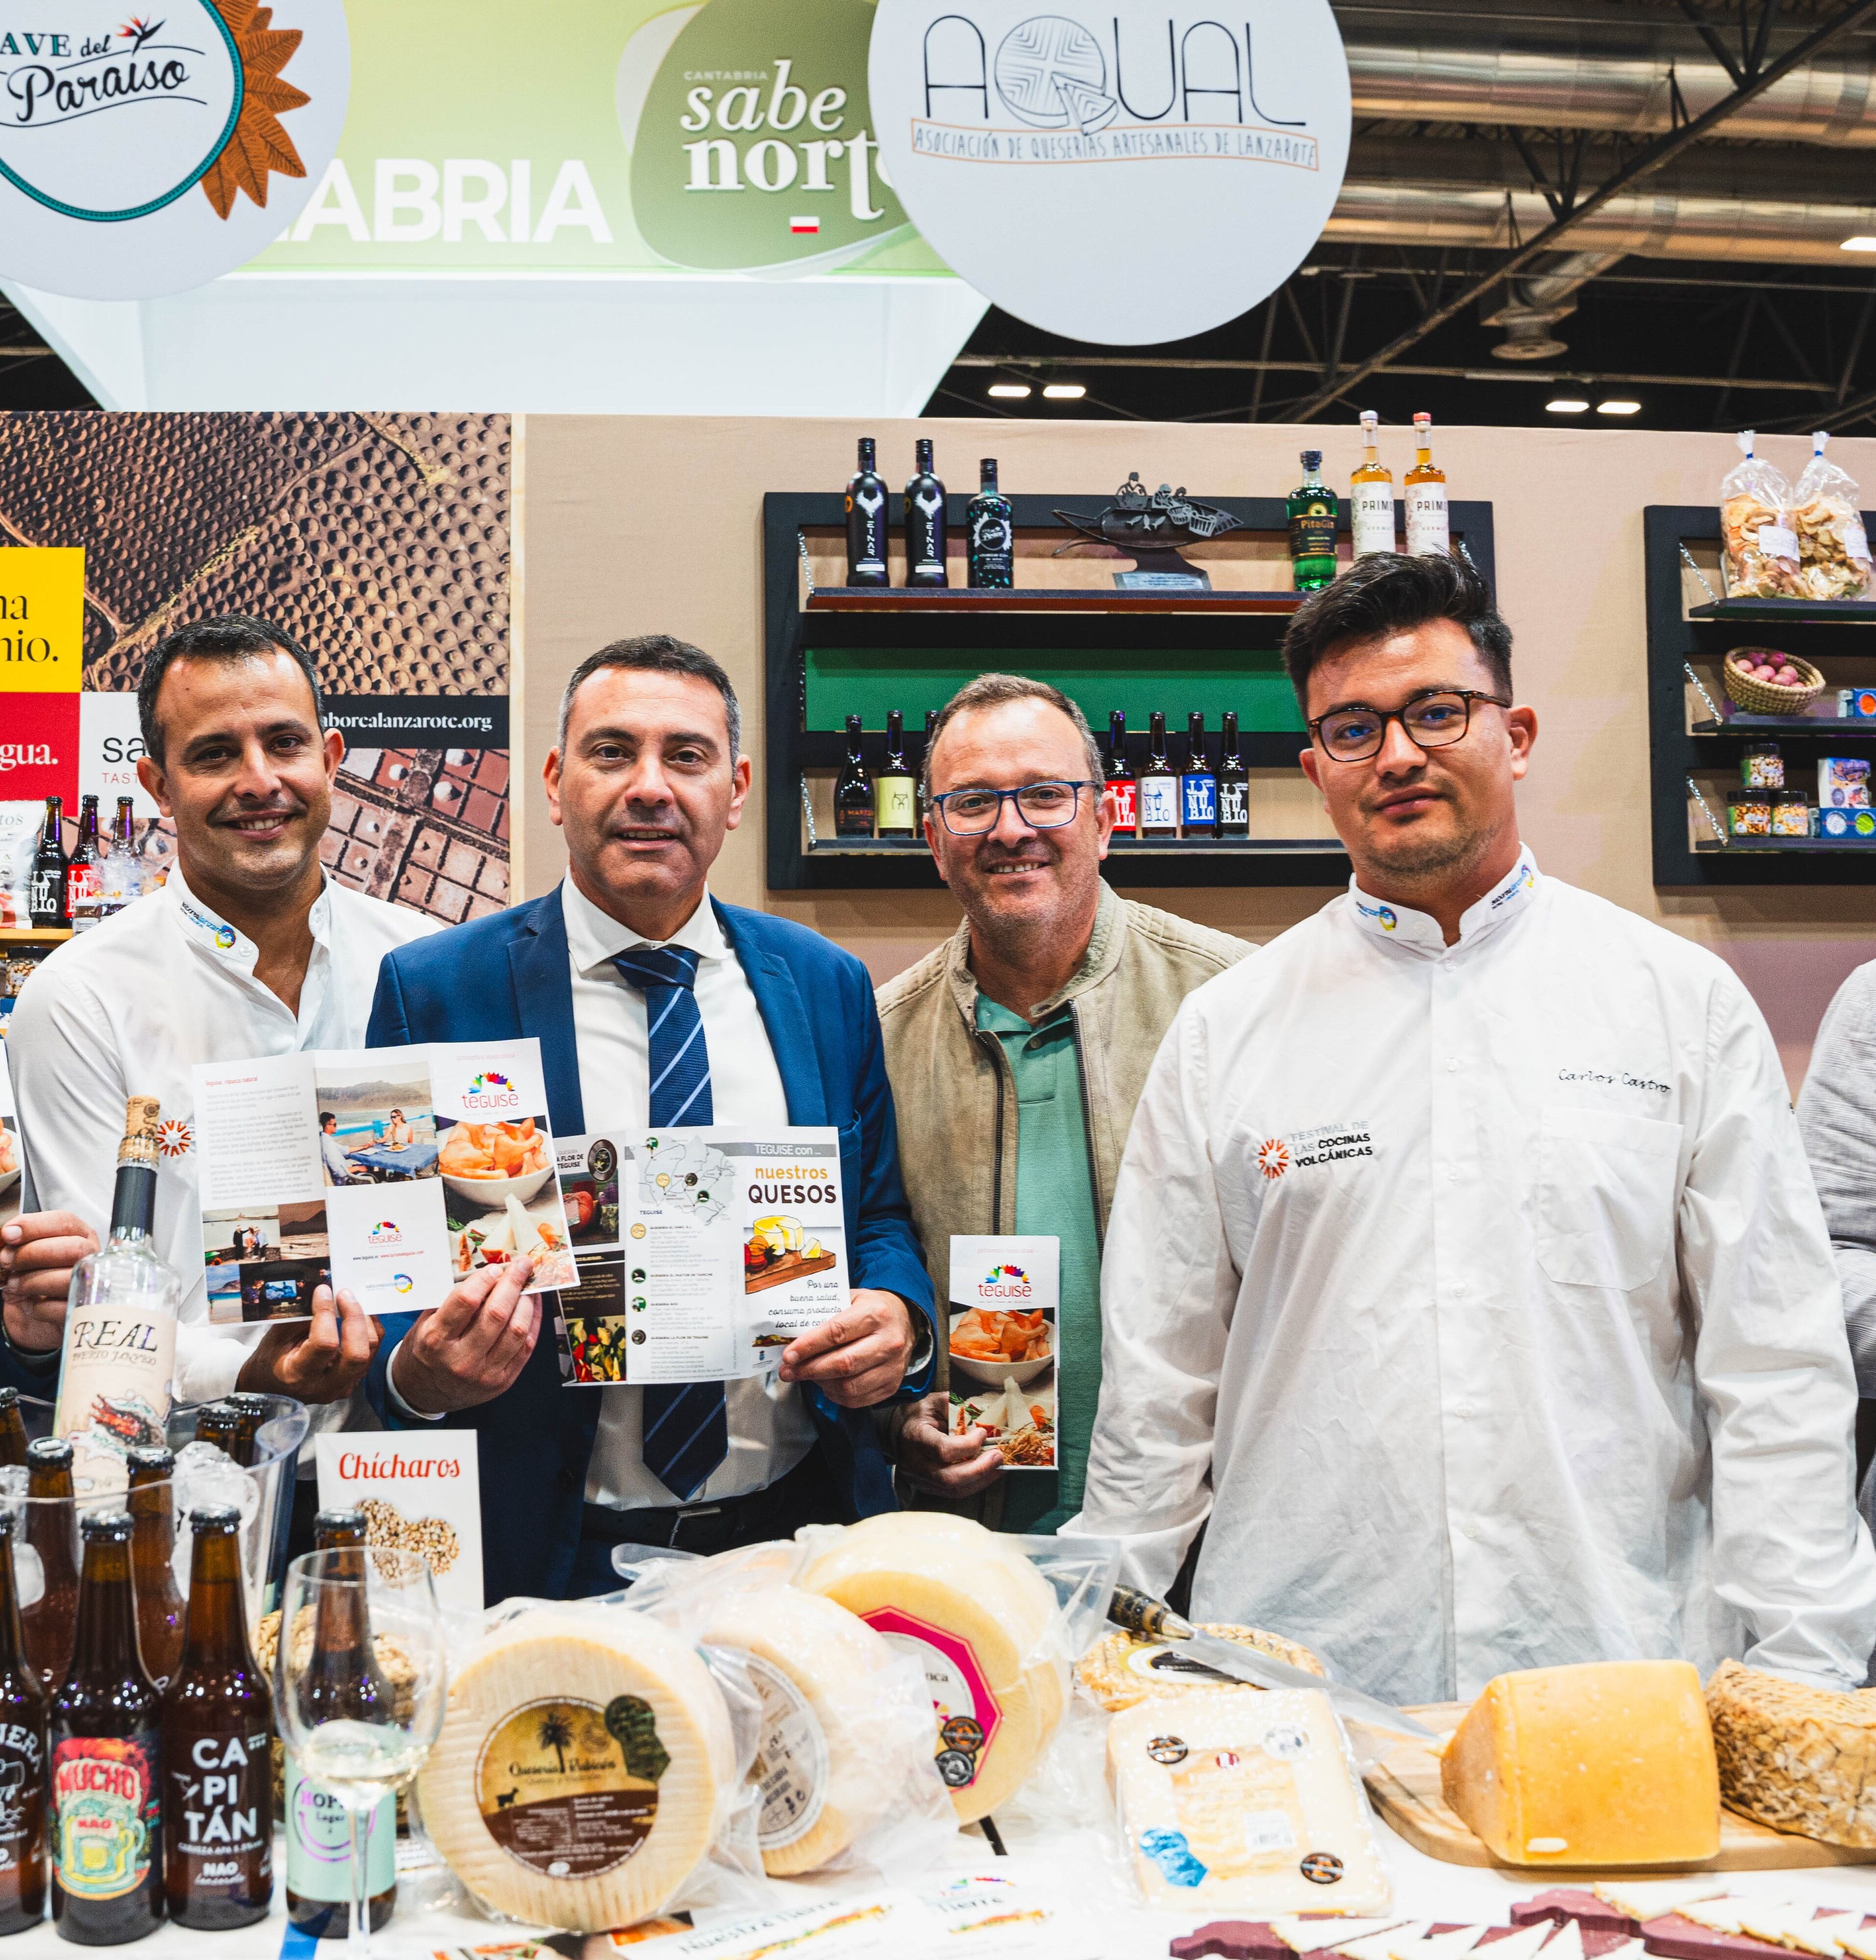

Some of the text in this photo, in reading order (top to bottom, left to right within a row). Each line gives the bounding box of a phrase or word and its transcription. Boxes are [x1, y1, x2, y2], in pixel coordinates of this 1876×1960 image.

[80, 34, 111, 58] del
[683, 71, 768, 80] CANTABRIA
[680, 59, 847, 131] sabe
[914, 132, 1316, 167] ASOCIACIÓN DE QUESERÍAS ARTESANALES DE LANZAROTE
[274, 158, 614, 243] ABRIA
[1558, 1069, 1672, 1093] Carlos Castro
[1291, 1121, 1369, 1142] FESTIVAL DE
[1318, 1133, 1370, 1149] COCINAS
[754, 1144, 794, 1155] TEGUISE
[795, 1147, 813, 1155] con
[1295, 1146, 1373, 1167] VOLCÁNICAS
[755, 1165, 828, 1180] nuestros
[748, 1184, 837, 1204] QUESOS
[775, 1320, 797, 1328] local
[74, 1321, 157, 1352] REAL
[339, 1451, 460, 1480] Chícharos
[192, 1737, 249, 1769] CA
[59, 1763, 136, 1800] MUCHO
[203, 1774, 238, 1806] PI
[78, 1819, 112, 1829] NAO
[183, 1805, 257, 1843] TÁN
[203, 1861, 239, 1877] NAO
